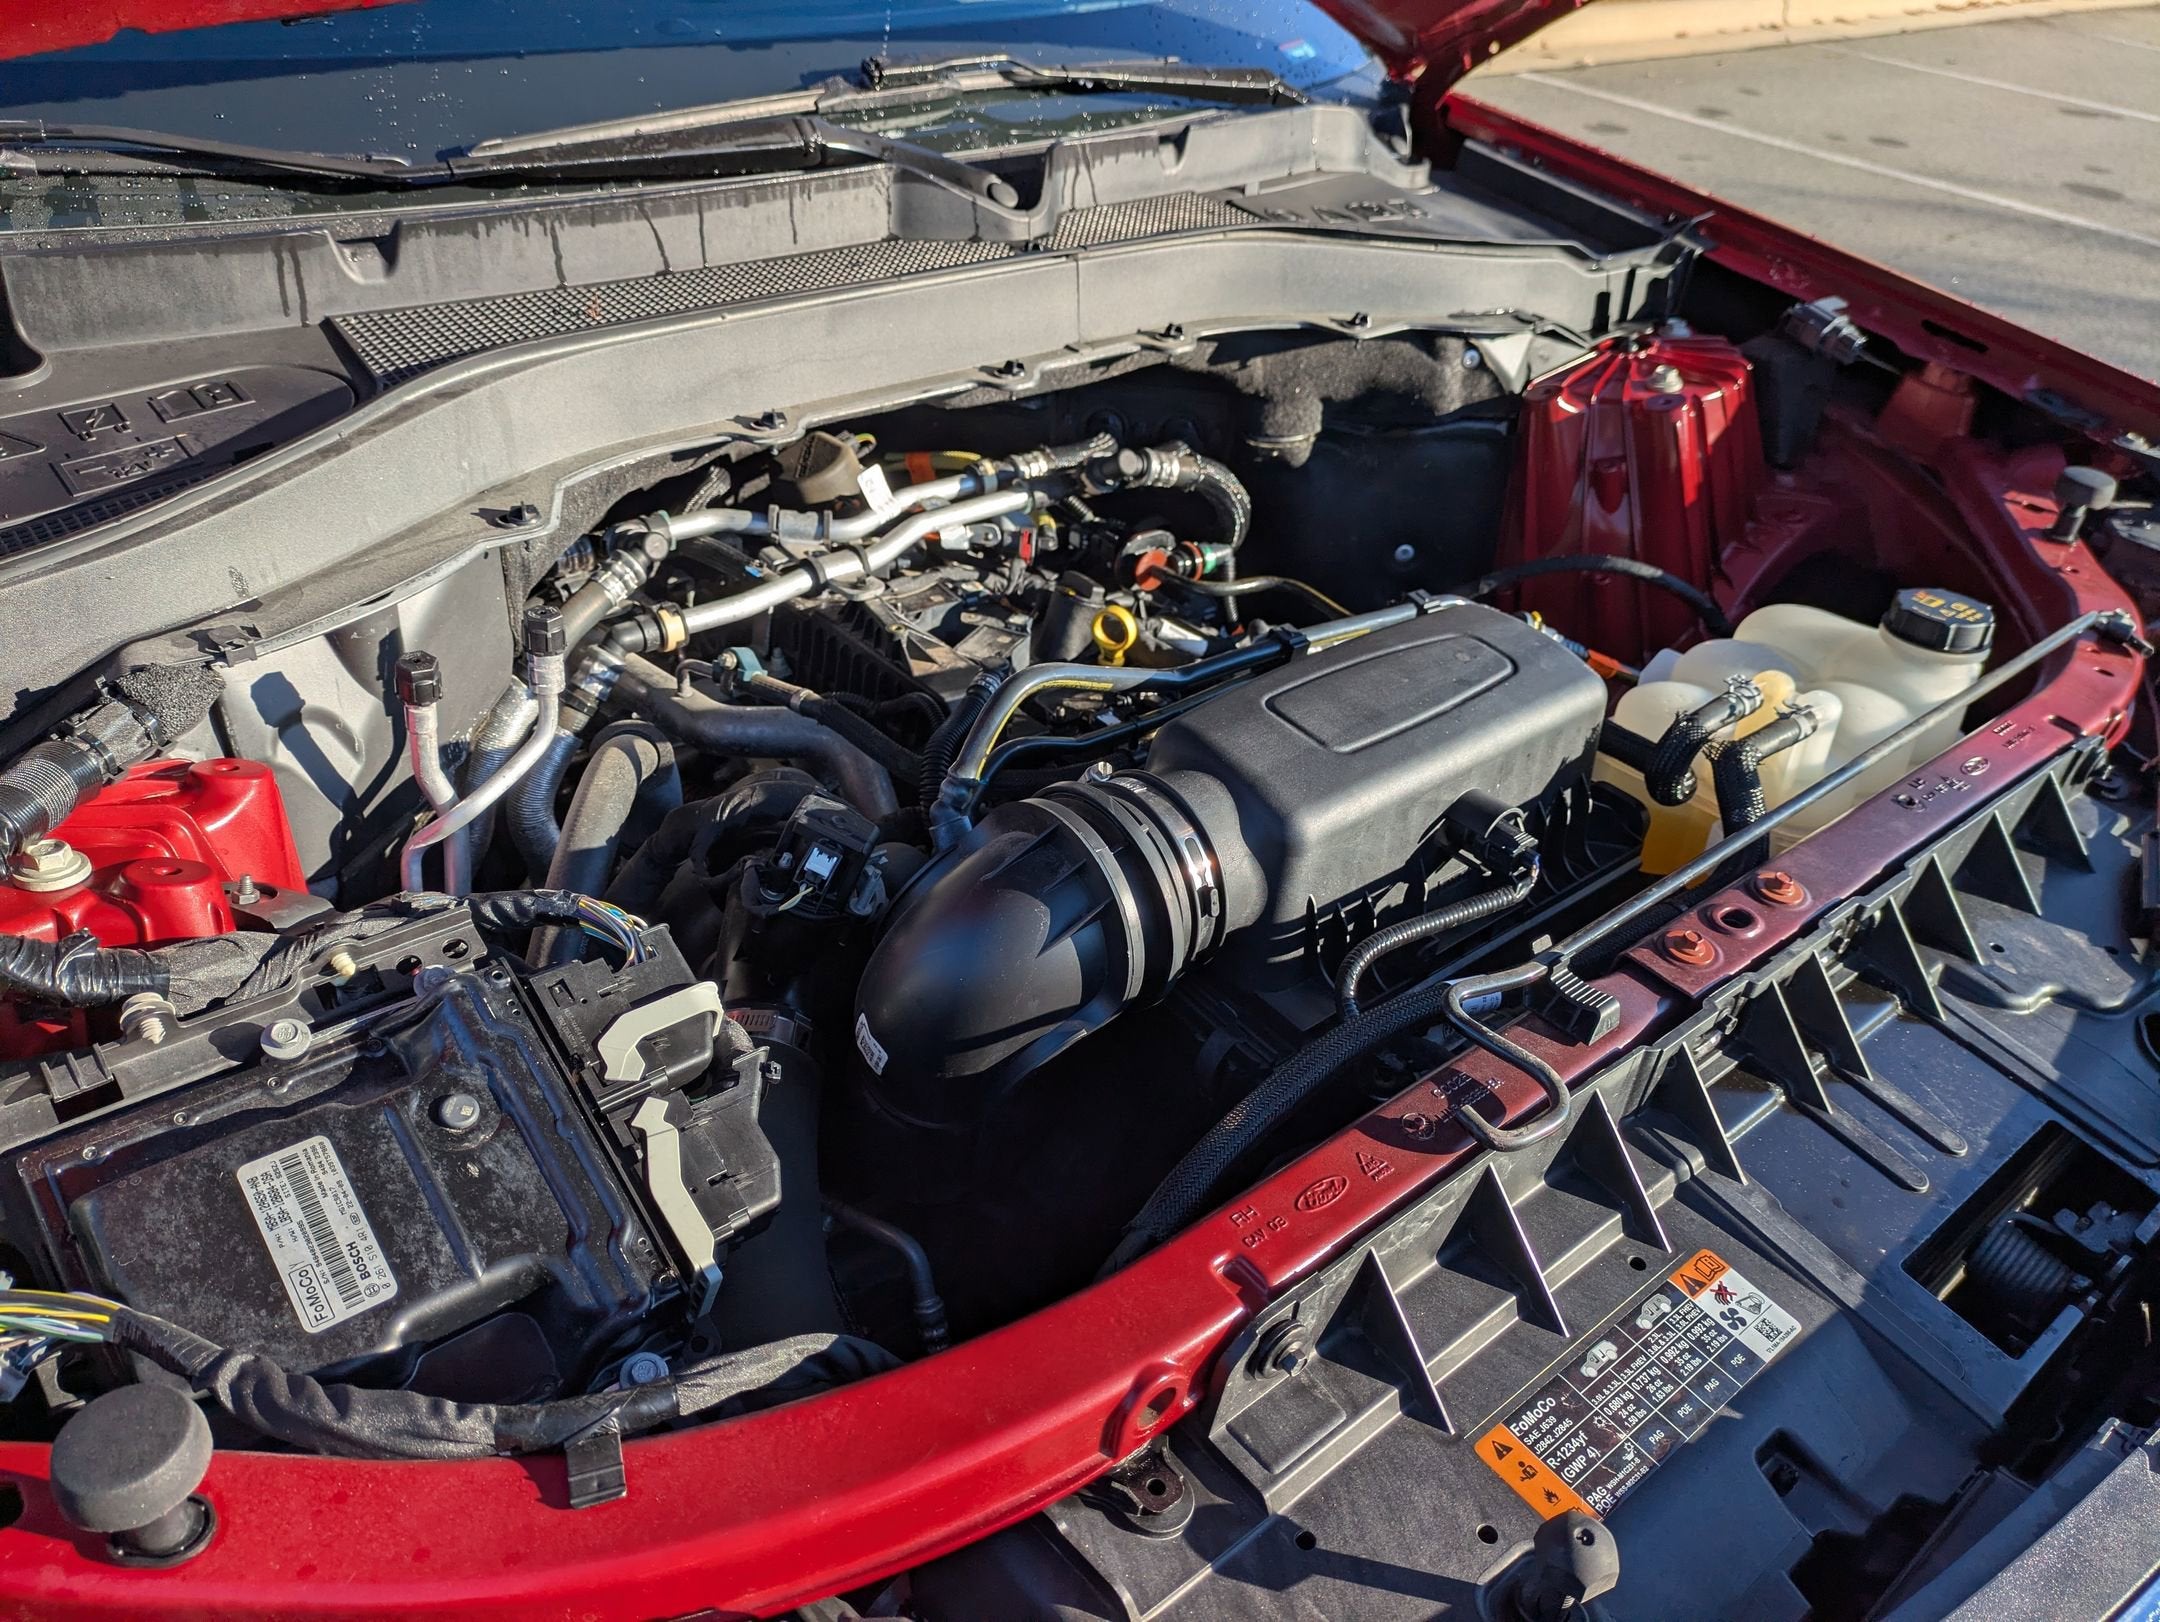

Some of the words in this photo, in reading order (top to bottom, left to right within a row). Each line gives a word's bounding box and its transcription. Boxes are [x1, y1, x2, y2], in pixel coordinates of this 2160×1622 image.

[302, 1147, 318, 1175] Romania
[313, 1173, 321, 1182] in
[279, 1180, 292, 1199] SITE:
[317, 1180, 329, 1199] Made
[1300, 1178, 1345, 1209] Ford
[1229, 1204, 1260, 1228] RH
[355, 1227, 368, 1241] 4R1
[345, 1241, 371, 1281] BOSCH
[319, 1269, 331, 1285] S/N:
[373, 1264, 387, 1280] 261
[381, 1282, 392, 1290] 0
[298, 1269, 328, 1323] FoMoCo
[1678, 1301, 1695, 1316] FHEV
[1685, 1306, 1701, 1322] PHEV
[1662, 1330, 1677, 1342] 3.3L
[1686, 1322, 1707, 1341] 0.992
[1700, 1317, 1716, 1328] kg
[1700, 1333, 1712, 1343] 35
[1708, 1329, 1718, 1338] oz
[1659, 1345, 1681, 1364] 0.992
[1674, 1339, 1690, 1351] kg
[1706, 1339, 1721, 1353] 2.19
[1716, 1334, 1729, 1344] lbs
[1619, 1367, 1635, 1380] 3.3L
[1630, 1354, 1647, 1371] FHEV
[1674, 1356, 1685, 1367] 35
[1682, 1351, 1692, 1361] oz
[1679, 1363, 1694, 1377] 2.19
[1689, 1357, 1703, 1368] lbs
[1730, 1353, 1746, 1368] POE
[1606, 1379, 1622, 1392] 3.3L
[1631, 1371, 1651, 1391] 0.737
[1646, 1366, 1662, 1377] kg
[1645, 1383, 1657, 1394] 26
[1653, 1378, 1664, 1388] oz
[1704, 1378, 1720, 1393] PAG
[1602, 1388, 1611, 1396] &
[1651, 1389, 1666, 1403] 1.63
[1661, 1383, 1674, 1394] lbs
[1603, 1396, 1624, 1416] 0.680
[1619, 1390, 1635, 1402] kg
[1617, 1408, 1629, 1419] 24
[1626, 1403, 1637, 1413] oz
[1676, 1403, 1693, 1418] POE
[1509, 1397, 1556, 1438] FoMoCo
[1624, 1414, 1639, 1428] 1.50
[1634, 1408, 1648, 1419] lbs
[1523, 1429, 1542, 1446] SAE
[1539, 1415, 1557, 1433] J639
[1534, 1434, 1555, 1455] J2842
[1552, 1417, 1573, 1438] J2845
[1648, 1429, 1665, 1445] PAG
[1546, 1430, 1588, 1469] R-1234yf
[1560, 1454, 1587, 1483] (GWP
[1586, 1446, 1601, 1461] 4)
[1586, 1486, 1610, 1506] PAG
[1594, 1493, 1617, 1514] POE
